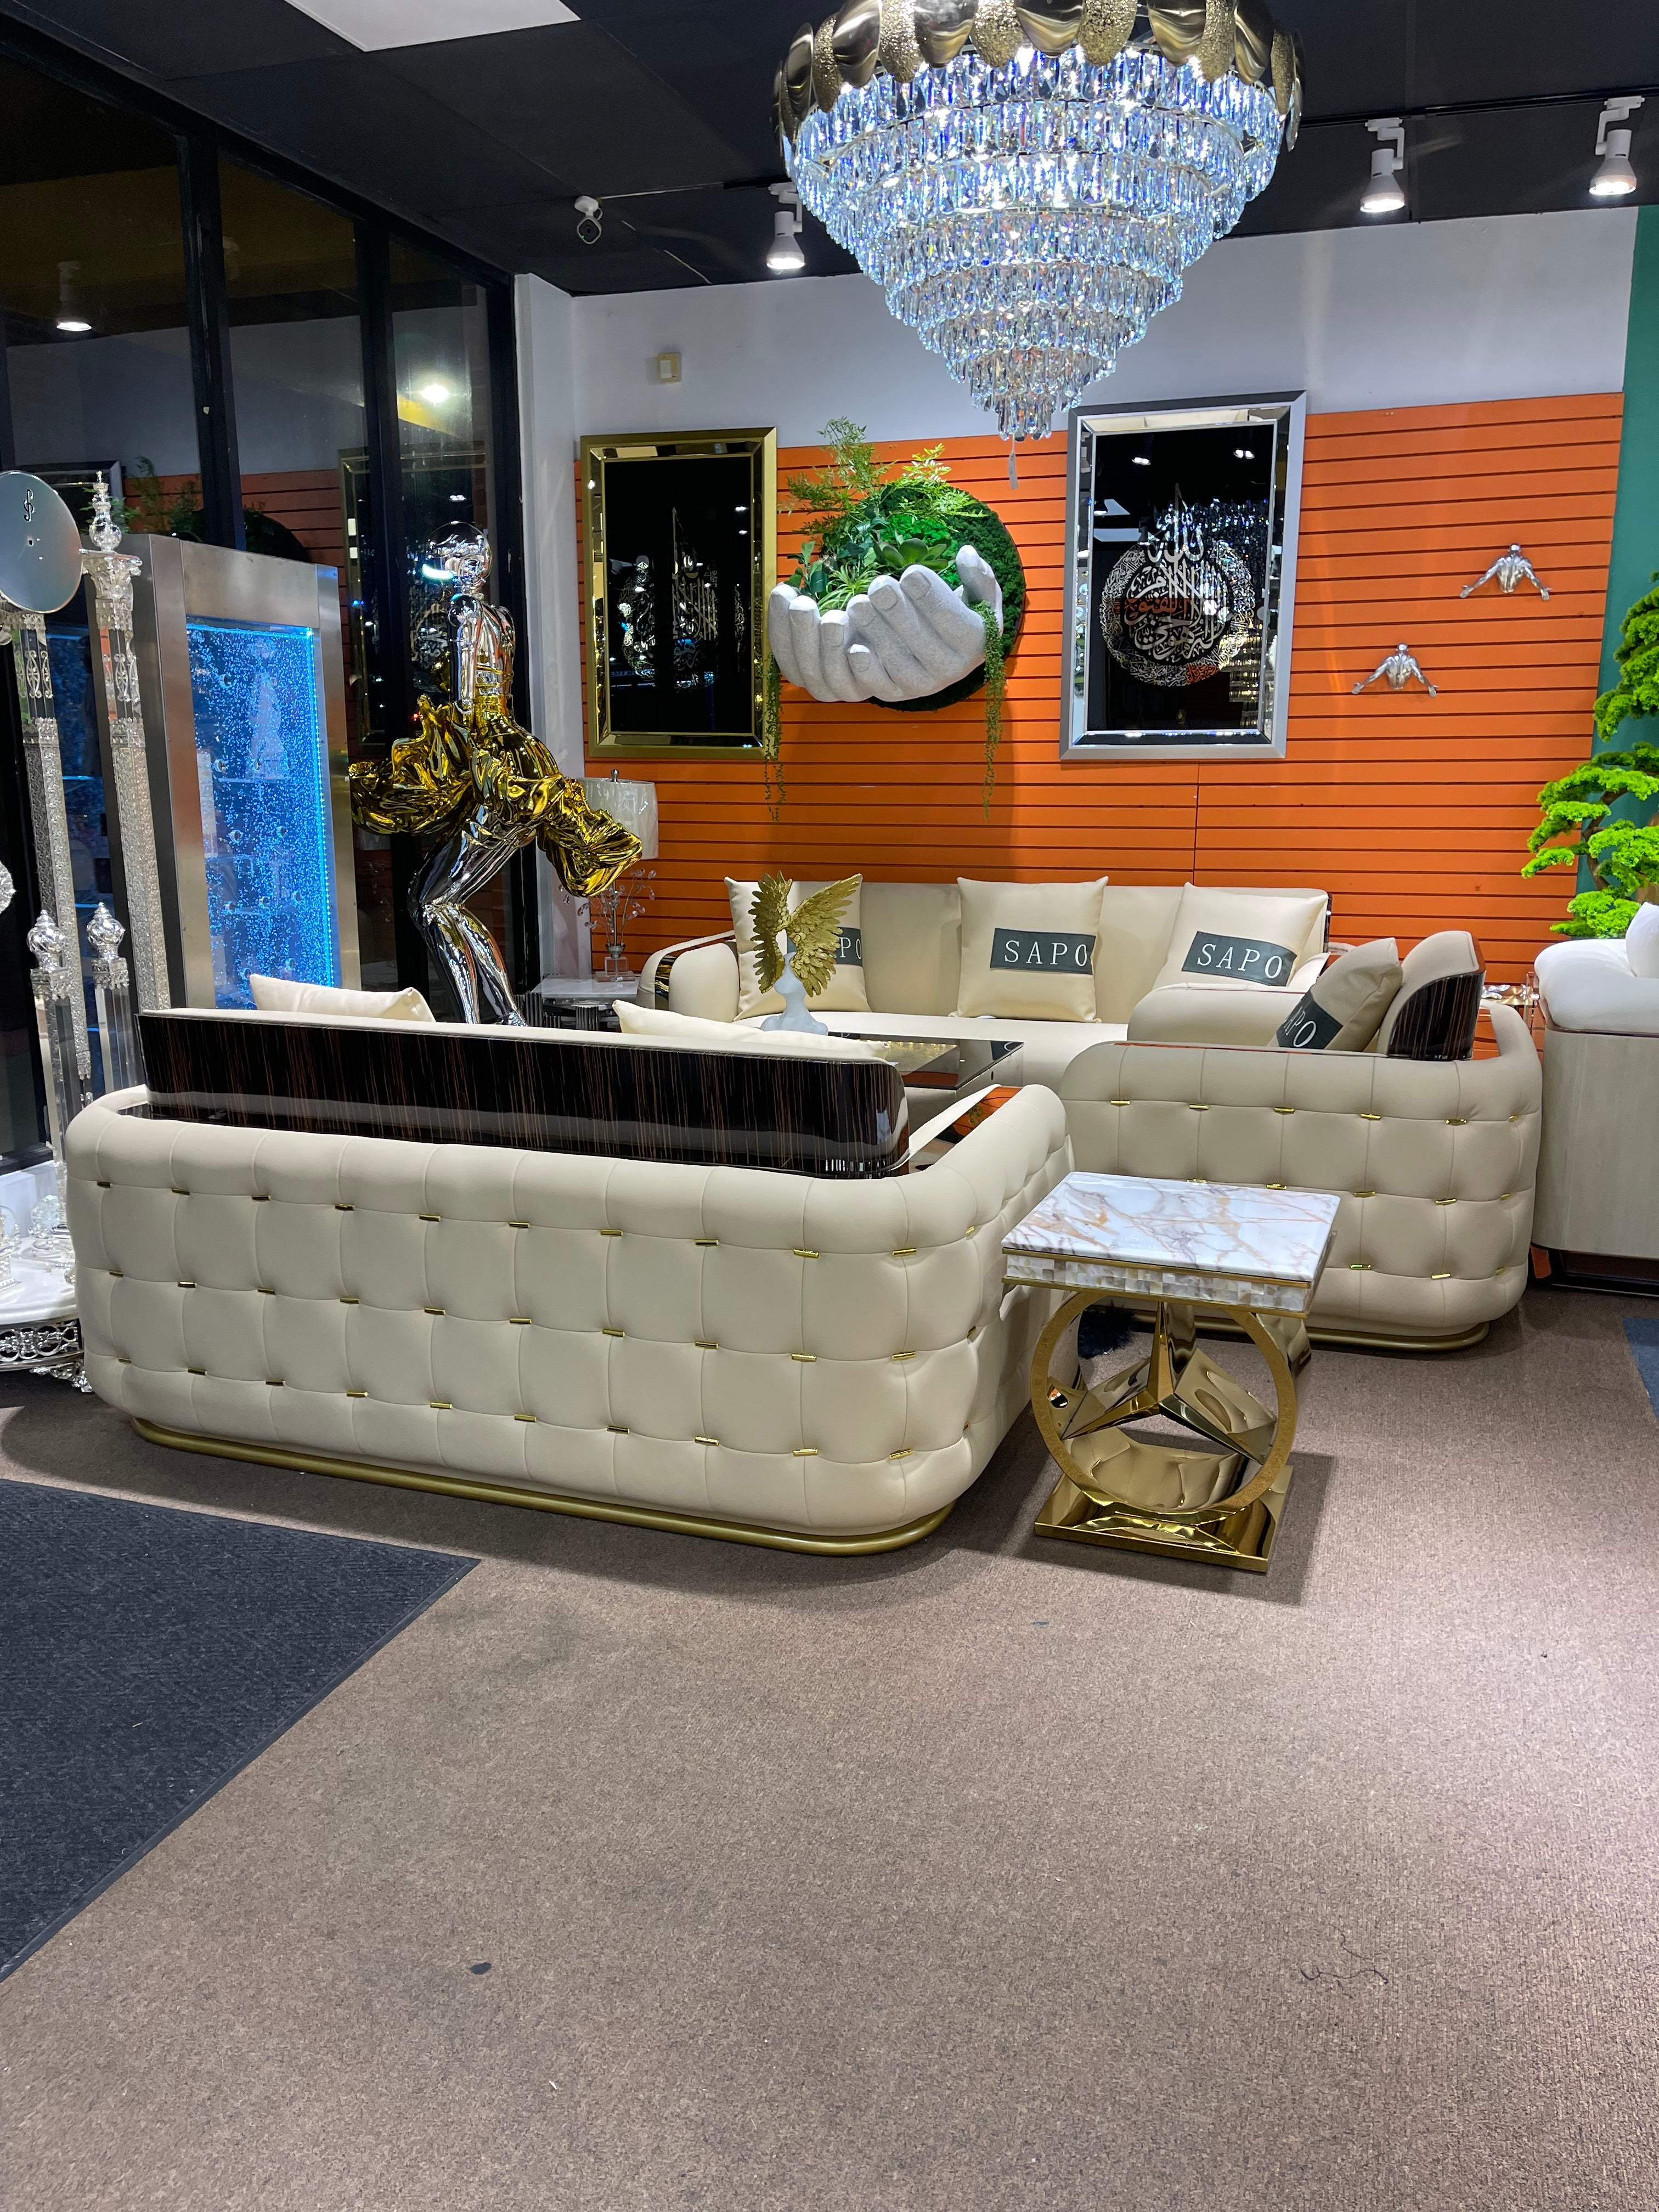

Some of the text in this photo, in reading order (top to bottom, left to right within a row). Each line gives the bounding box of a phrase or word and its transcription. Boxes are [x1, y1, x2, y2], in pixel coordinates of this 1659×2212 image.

[839, 937, 862, 960] PO
[1005, 940, 1087, 967] SAPO
[1197, 944, 1283, 978] SAPO
